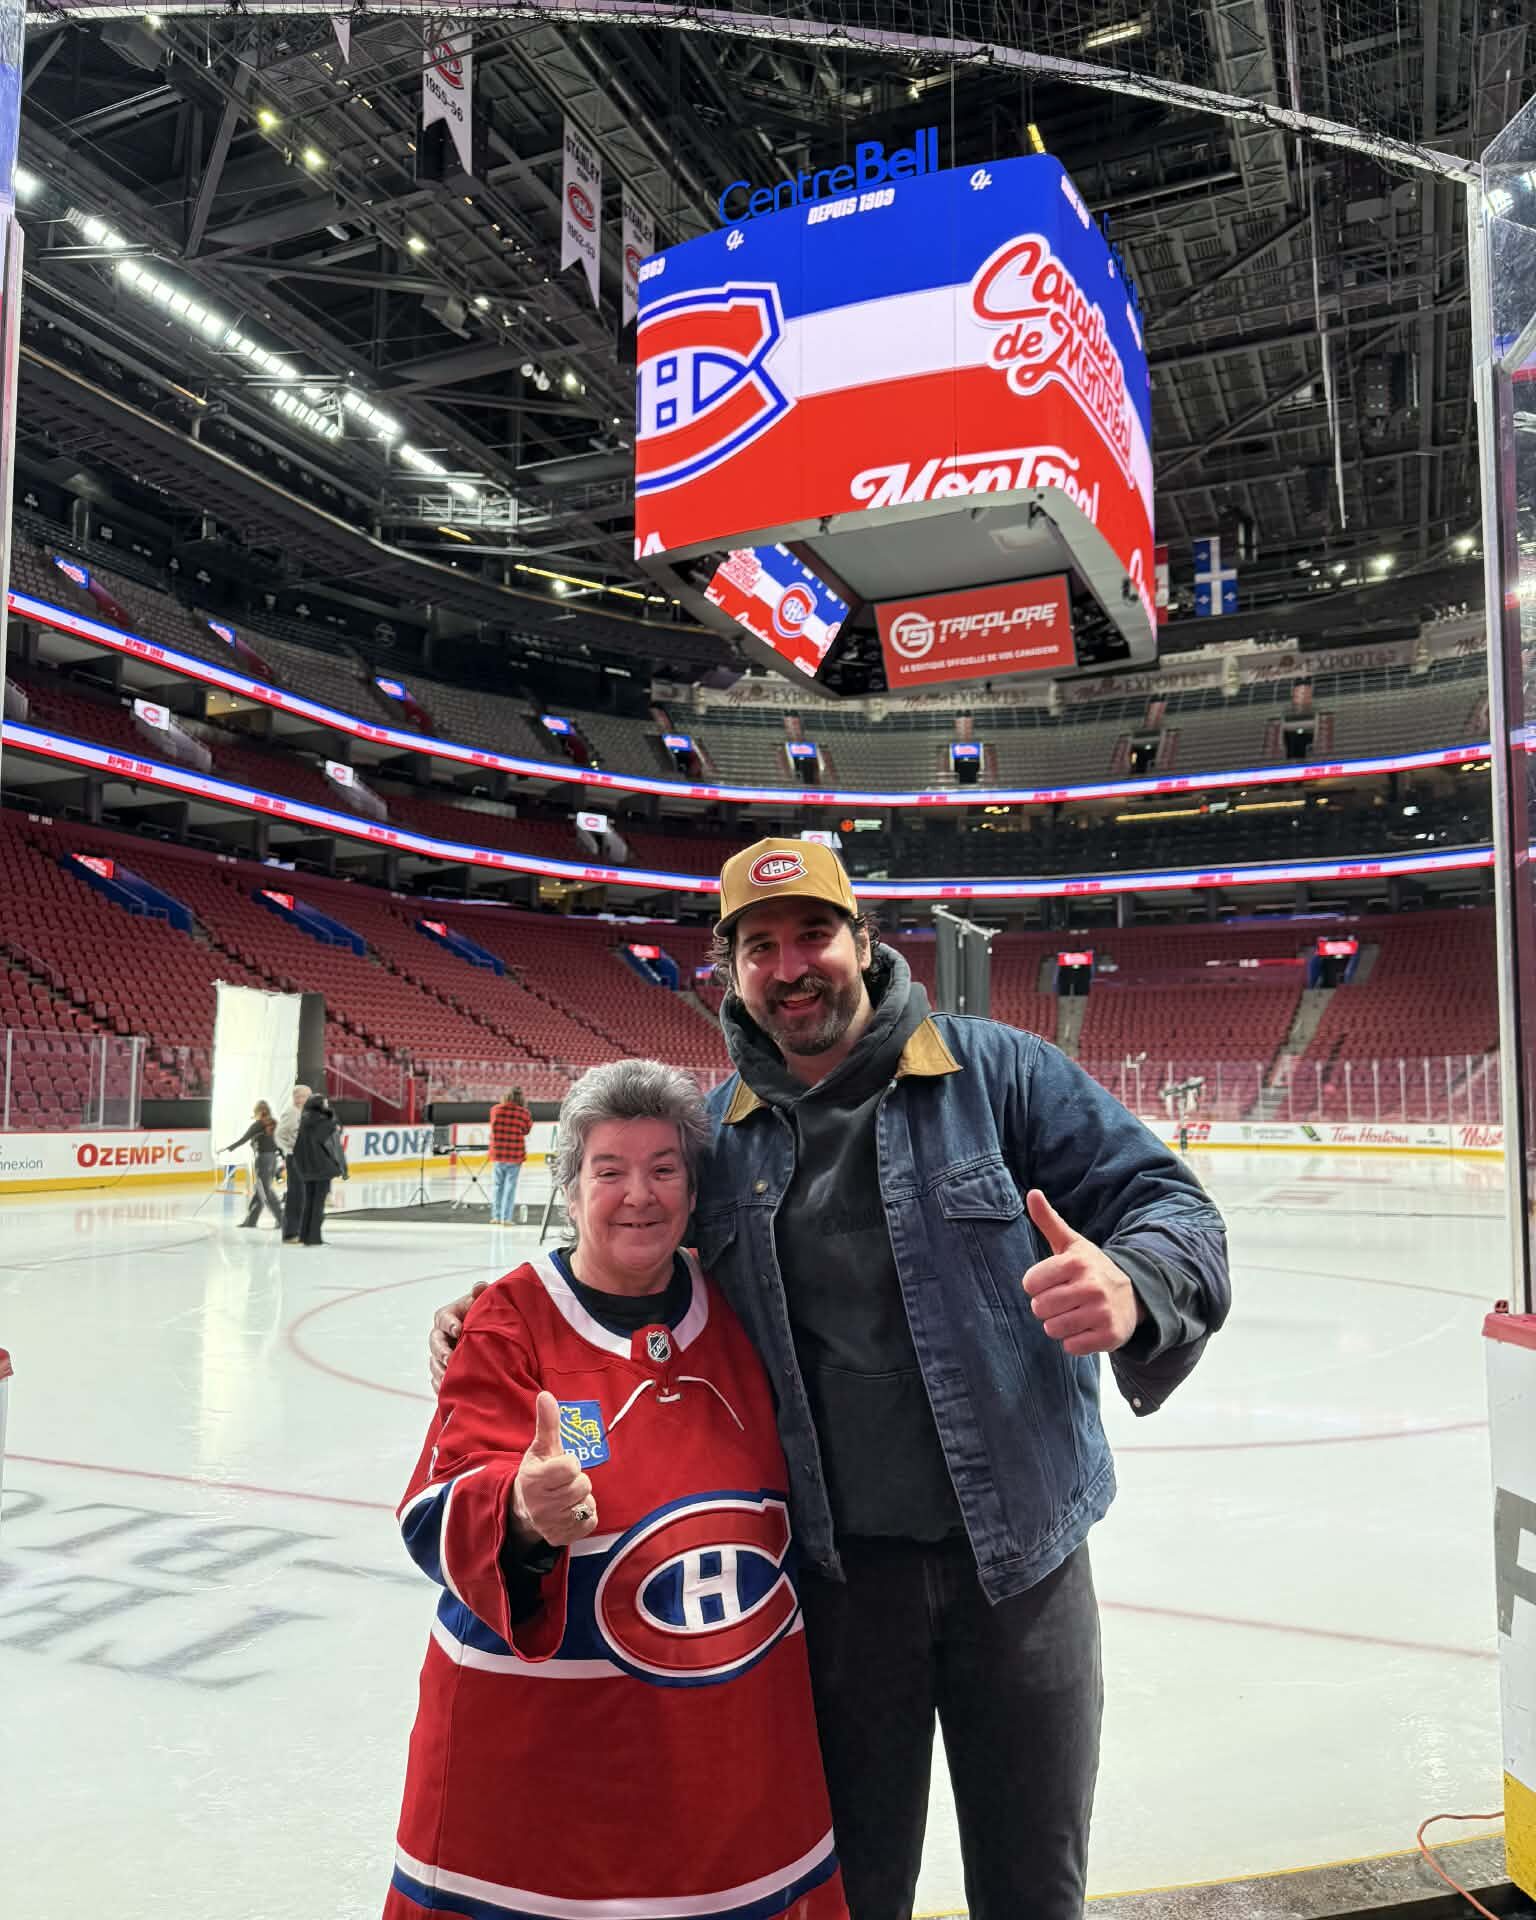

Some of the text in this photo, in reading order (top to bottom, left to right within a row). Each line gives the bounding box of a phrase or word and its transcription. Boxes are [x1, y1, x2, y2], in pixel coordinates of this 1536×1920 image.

[807, 187, 896, 226] DEPUIS 1909
[993, 324, 1043, 362] de
[938, 602, 1059, 634] TRICOLORE
